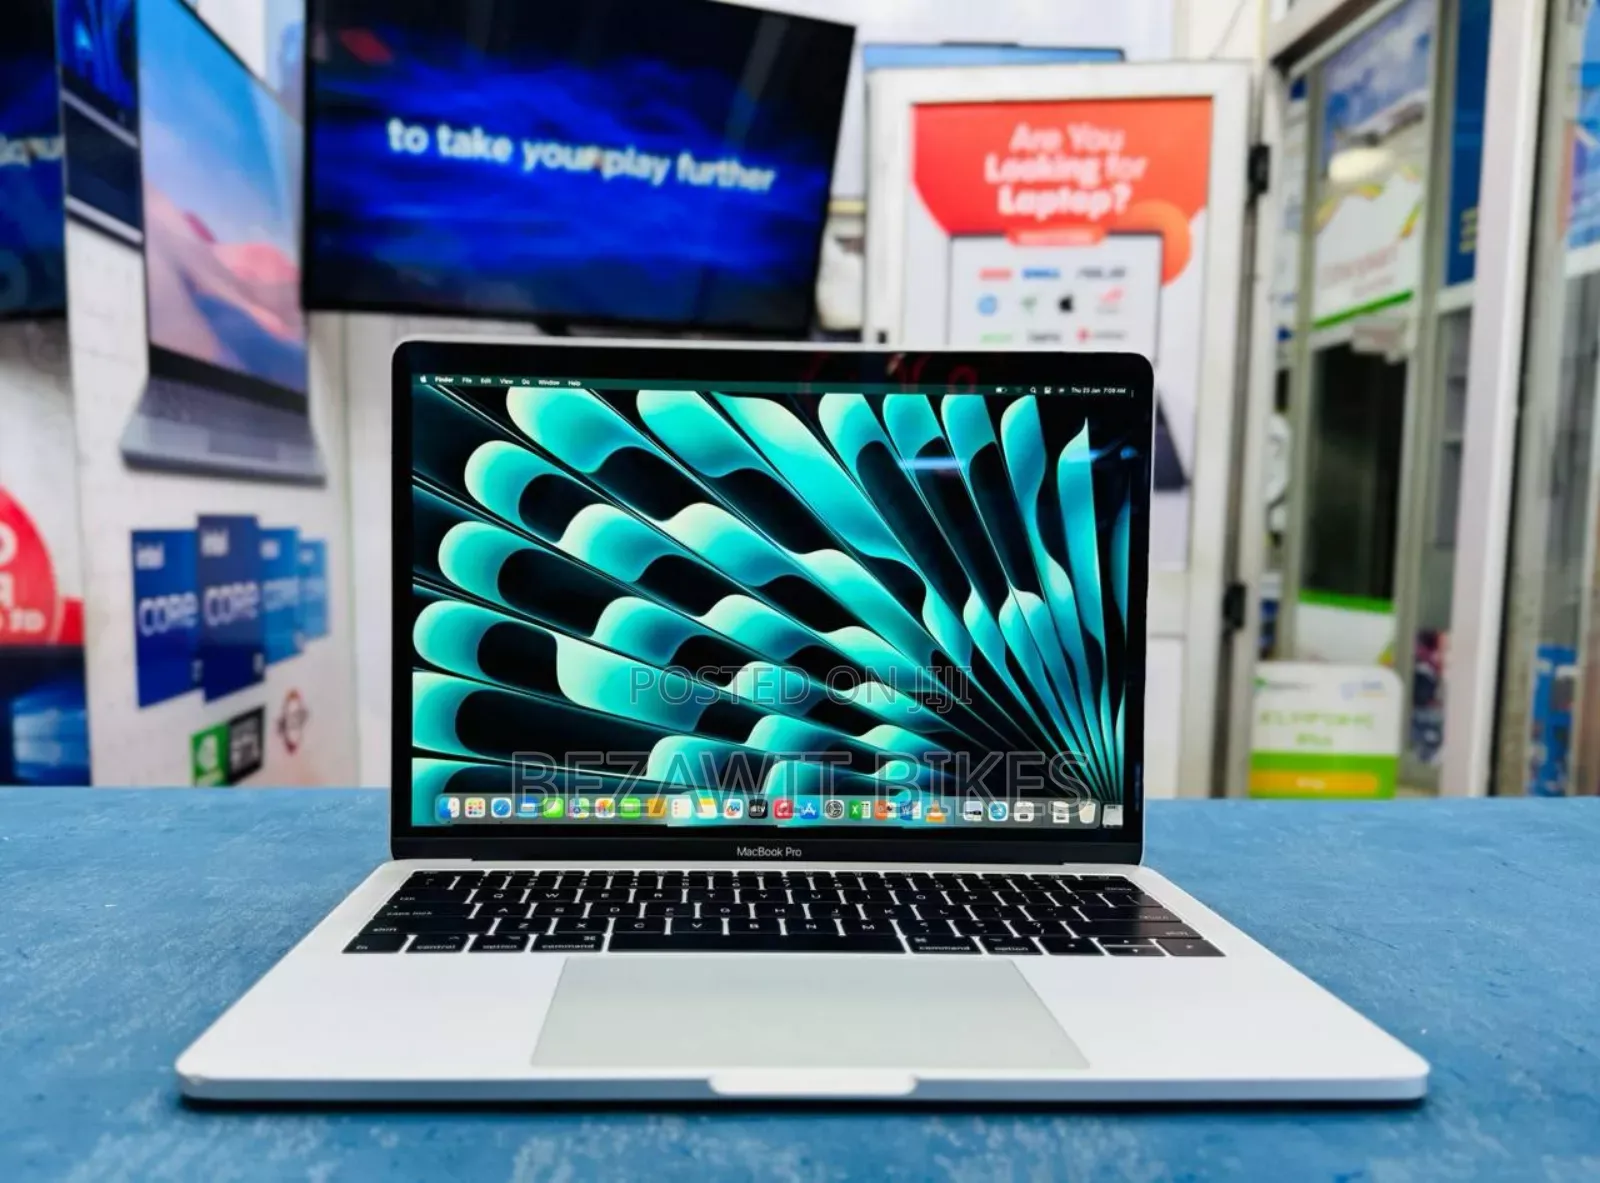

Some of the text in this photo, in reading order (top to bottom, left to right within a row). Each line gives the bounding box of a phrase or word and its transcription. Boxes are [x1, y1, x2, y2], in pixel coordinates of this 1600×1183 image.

[388, 118, 428, 154] to
[437, 124, 512, 163] take
[600, 144, 670, 186] play
[676, 151, 776, 193] further
[984, 152, 1101, 188] Looking
[998, 181, 1132, 221] Laptop?
[737, 846, 802, 857] MacBook Pro
